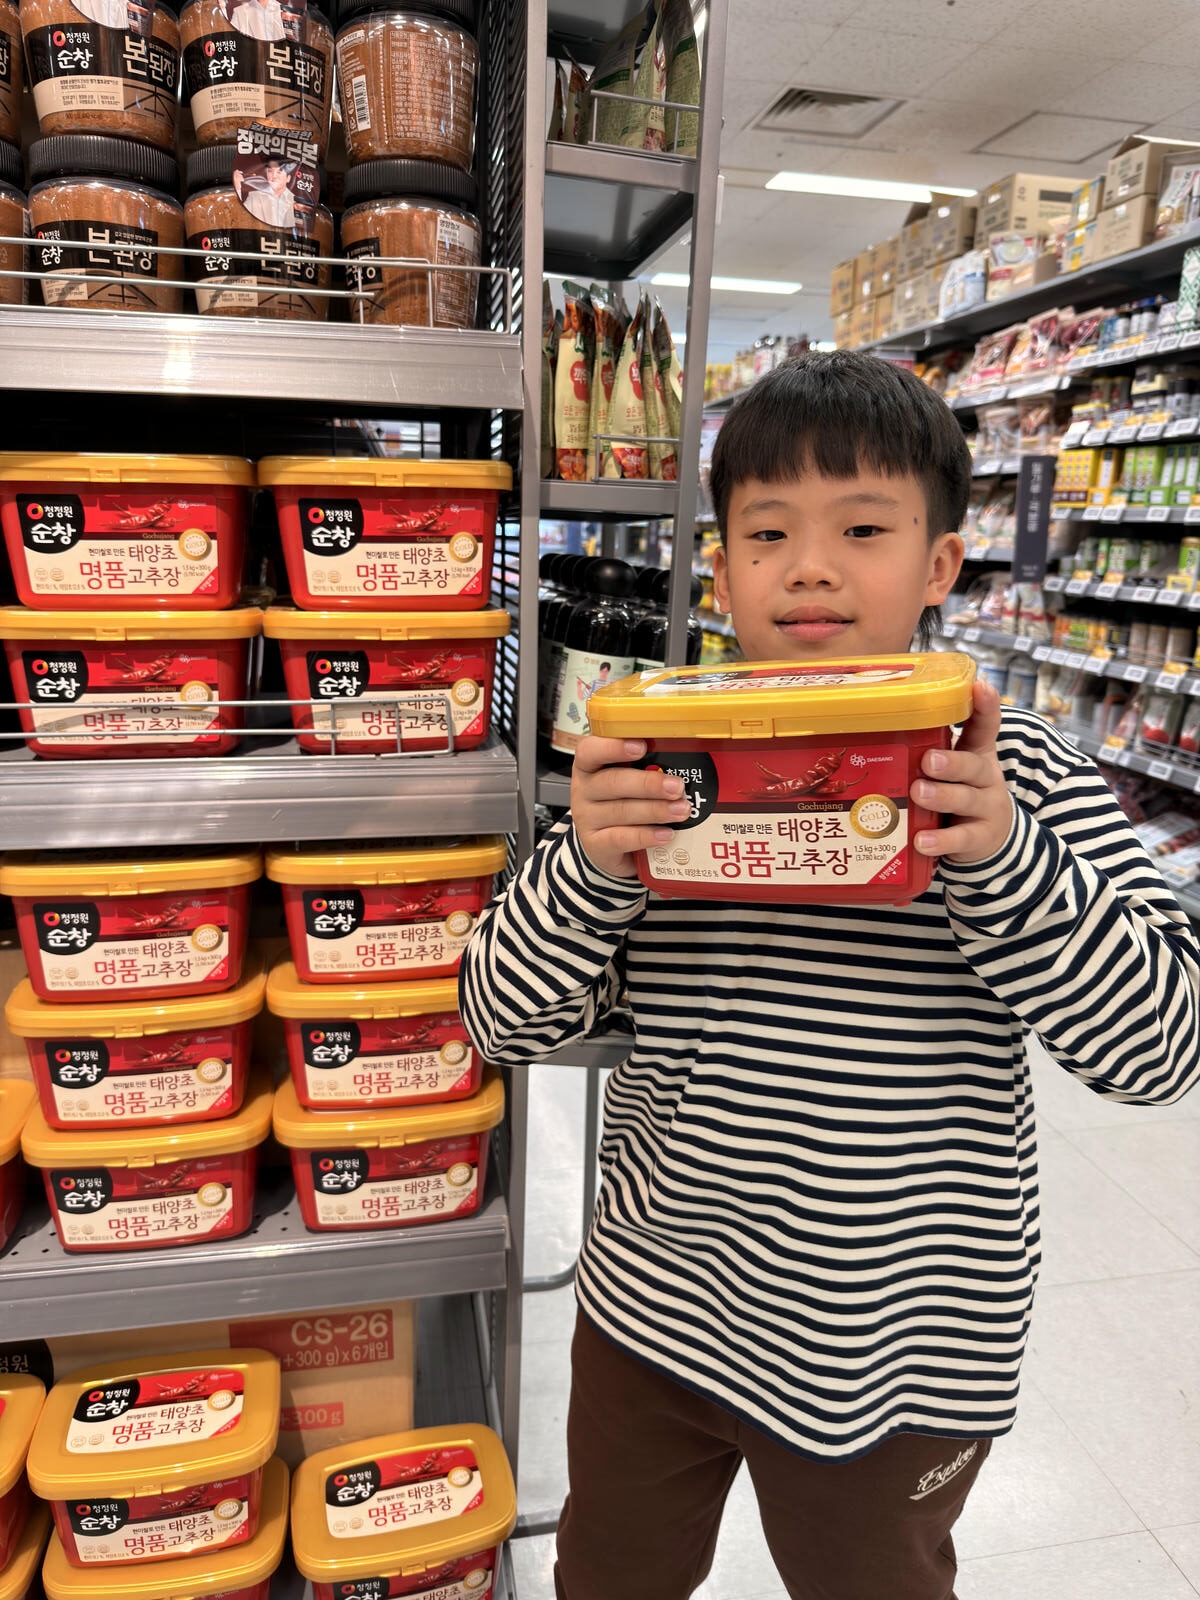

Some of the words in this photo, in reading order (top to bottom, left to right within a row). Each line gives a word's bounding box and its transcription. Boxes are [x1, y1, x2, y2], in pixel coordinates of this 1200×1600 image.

[66, 32, 91, 44] 청정원
[215, 40, 237, 52] 청정원
[57, 49, 93, 69] 순창
[122, 36, 176, 88] 본된장
[208, 56, 239, 79] 순창
[266, 43, 324, 95] 본된장
[41, 246, 64, 266] 순창
[44, 506, 73, 518] 청정원
[324, 510, 352, 522] 청정원
[31, 522, 77, 545] 순창
[310, 526, 355, 548] 순창
[128, 544, 178, 563] 태양초
[403, 547, 448, 565] 태양초
[49, 661, 77, 673] 청정원
[332, 661, 359, 672] 청정원
[36, 677, 80, 698] 순창
[318, 676, 361, 697] 순창
[797, 802, 843, 812] Gochujang
[859, 810, 890, 823] GOLD
[722, 823, 755, 835] 현미쌀로
[755, 823, 773, 835] 만든
[777, 817, 847, 843] 태양초
[327, 899, 354, 910] 청정원
[61, 912, 89, 924] 청정원
[313, 913, 356, 933] 순창
[47, 927, 93, 948] 순창
[401, 925, 443, 943] 태양초
[142, 940, 191, 959] 태양초
[325, 1031, 351, 1042] 청정원
[71, 1049, 99, 1061] 청정원
[312, 1044, 353, 1064] 순창
[396, 1054, 439, 1072] 태양초
[59, 1064, 102, 1083] 순창
[149, 1073, 196, 1091] 태양초
[334, 1159, 360, 1169] 청정원
[76, 1177, 102, 1188] 청정원
[321, 1171, 361, 1189] 순창
[404, 1179, 446, 1195] 태양초
[63, 1190, 106, 1208] 순창
[151, 1198, 197, 1215] 태양초
[291, 1312, 388, 1347] CS-26
[105, 1388, 131, 1399] 청정원
[86, 1399, 129, 1418] 순창
[160, 1403, 206, 1420] 태양초
[349, 1470, 372, 1483] 청정원
[336, 1484, 375, 1502] 순창
[407, 1482, 449, 1499] 태양초
[92, 1504, 119, 1514] 청정원
[79, 1515, 121, 1531] 순창
[168, 1514, 213, 1532] 태양초
